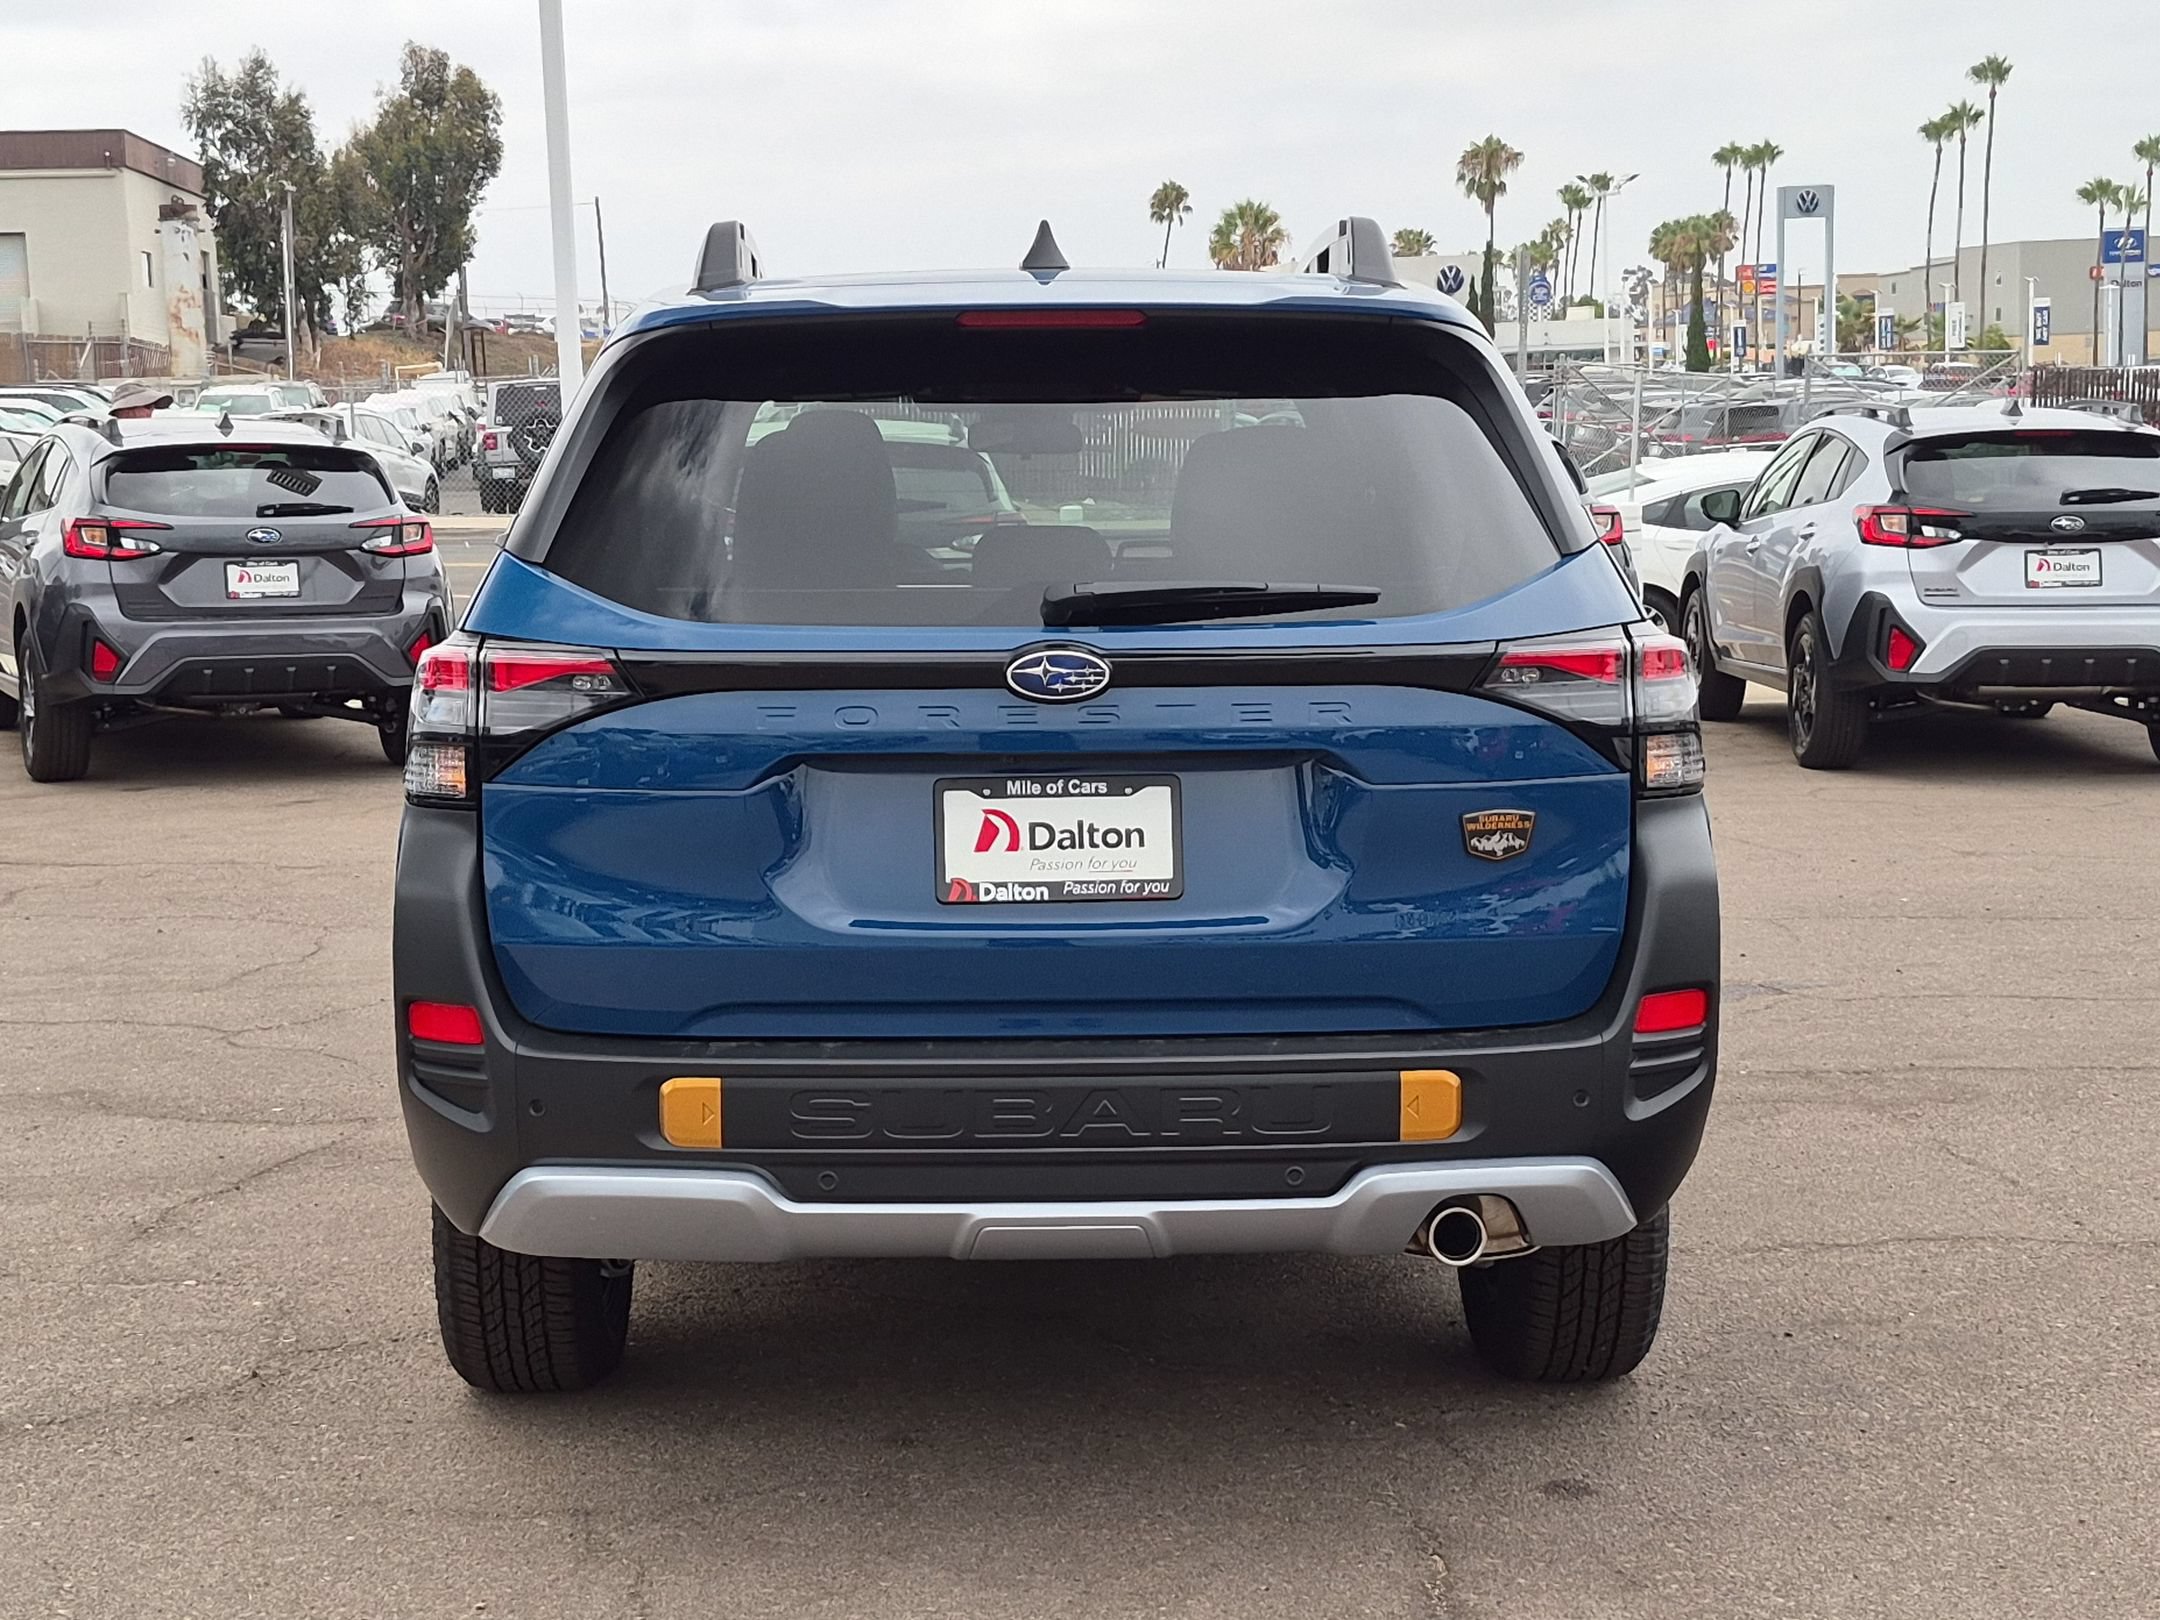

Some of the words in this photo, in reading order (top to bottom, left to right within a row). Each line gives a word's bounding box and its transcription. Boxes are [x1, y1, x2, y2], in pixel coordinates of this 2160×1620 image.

[2110, 279, 2142, 288] Dlton
[2053, 562, 2090, 572] Dalton
[253, 573, 290, 583] Dalton
[753, 701, 1353, 731] FORESTER
[1006, 780, 1042, 796] Mile
[1045, 779, 1065, 794] of
[1067, 778, 1108, 794] Cars
[1466, 820, 1531, 831] WILDERNESS
[1478, 814, 1520, 822] SUBARU
[1028, 820, 1146, 851] Dalton
[1029, 858, 1083, 872] Passion
[1087, 856, 1109, 870] for
[1110, 858, 1137, 872] you
[978, 882, 1049, 901] Dalton
[1062, 880, 1116, 895] Passion
[1119, 879, 1140, 894] for
[1142, 881, 1170, 896] you
[790, 1085, 1332, 1139] SUBARU
